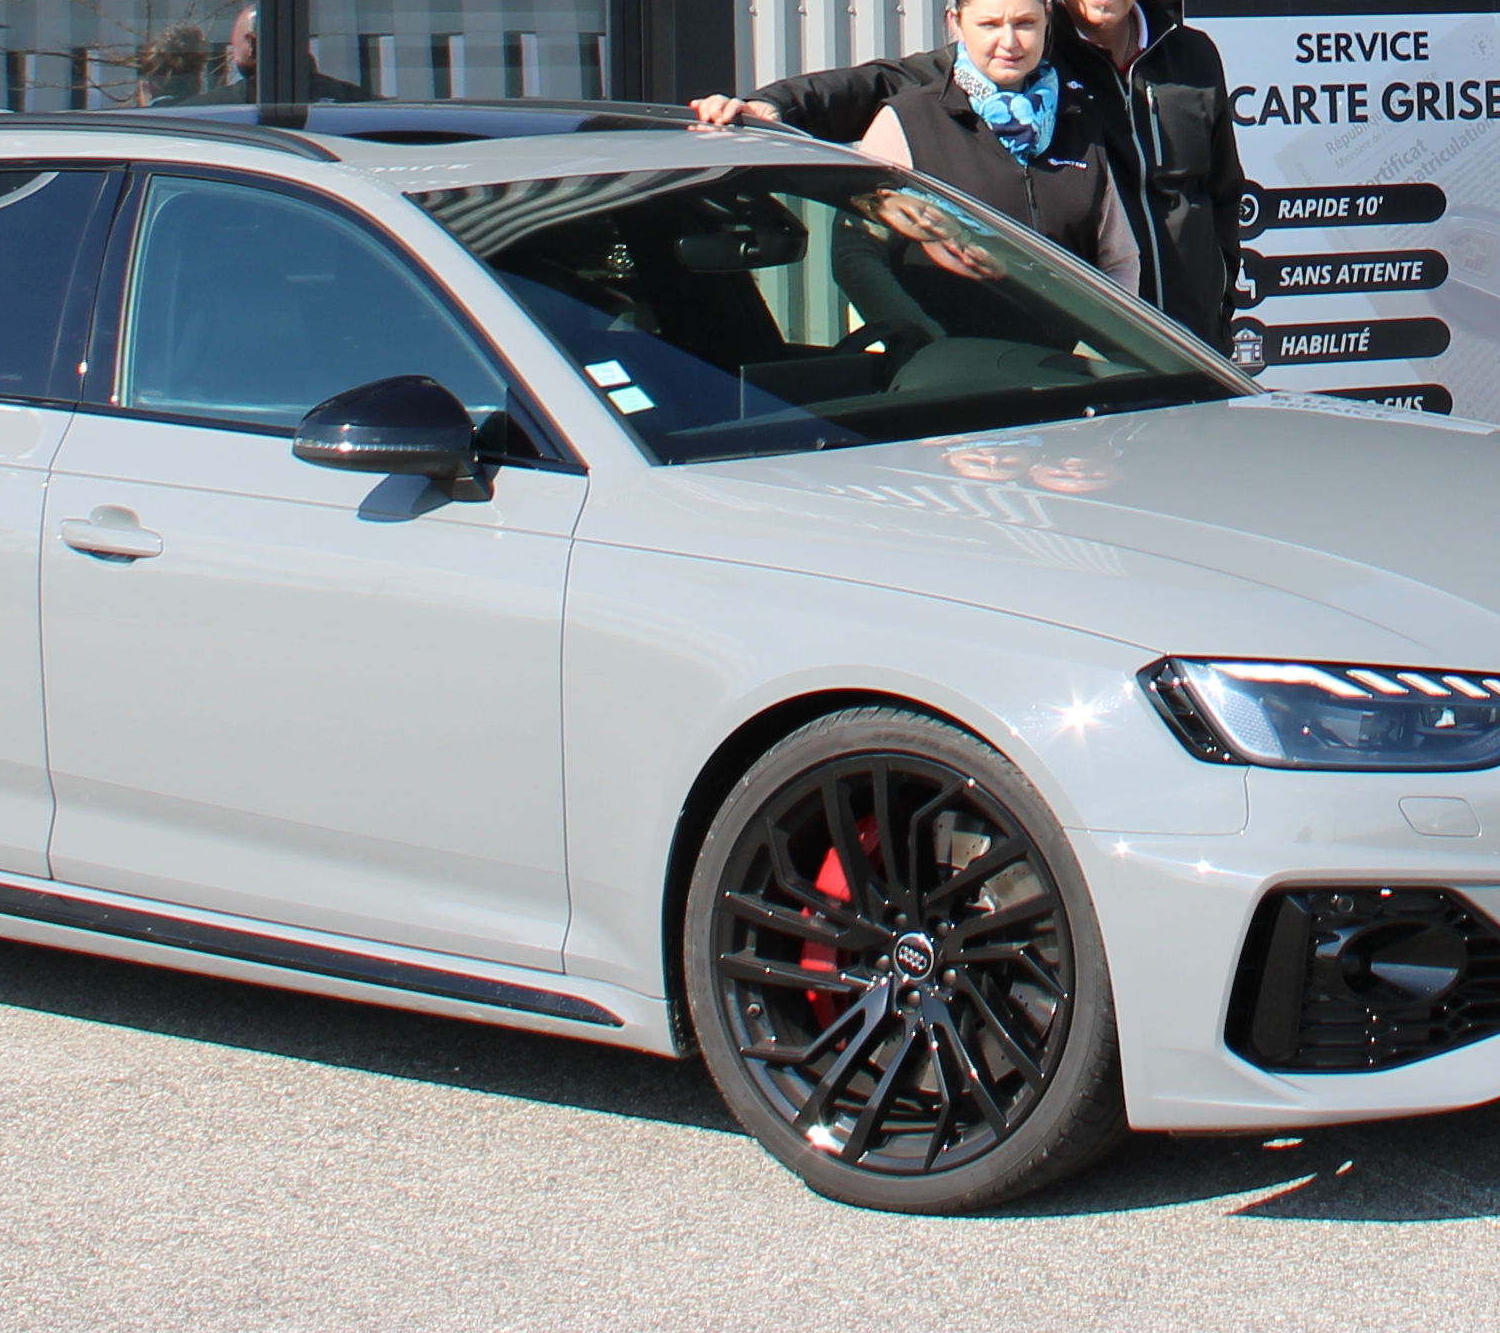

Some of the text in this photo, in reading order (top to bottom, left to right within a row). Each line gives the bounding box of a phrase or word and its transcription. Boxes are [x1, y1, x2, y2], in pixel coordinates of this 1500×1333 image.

[1294, 31, 1430, 64] SERVICE
[1231, 83, 1369, 127] CARTE
[1277, 195, 1383, 219] RAPIDE 10'
[1279, 261, 1424, 288] SANS ATTENTE
[1280, 326, 1371, 357] HABILITÉ
